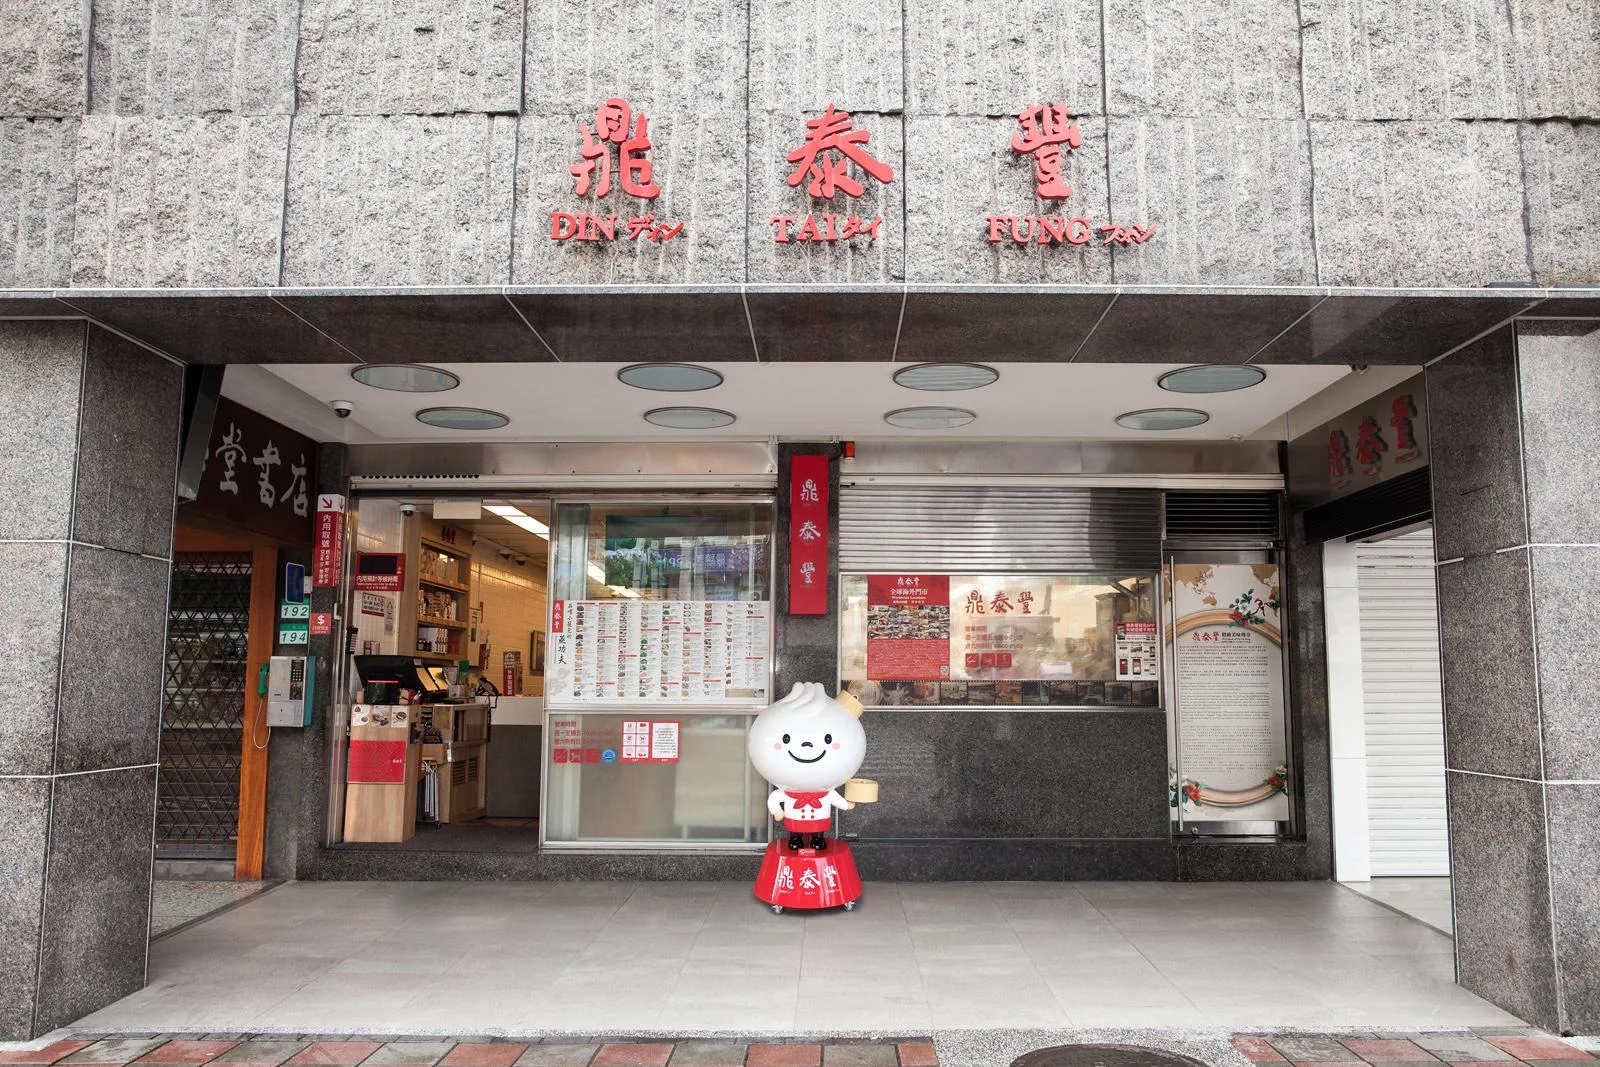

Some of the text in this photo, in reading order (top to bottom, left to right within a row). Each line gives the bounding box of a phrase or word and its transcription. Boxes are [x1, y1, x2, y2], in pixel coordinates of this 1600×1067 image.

[550, 212, 1156, 245] DIN ディン TAI タイ FUNG フォン
[201, 421, 309, 518] 堂書店
[799, 478, 821, 584] 鼎泰豐
[283, 606, 308, 617] 192
[965, 589, 1034, 615] 鼎泰豐
[282, 632, 306, 643] 194
[778, 865, 838, 889] 鼎泰豐
